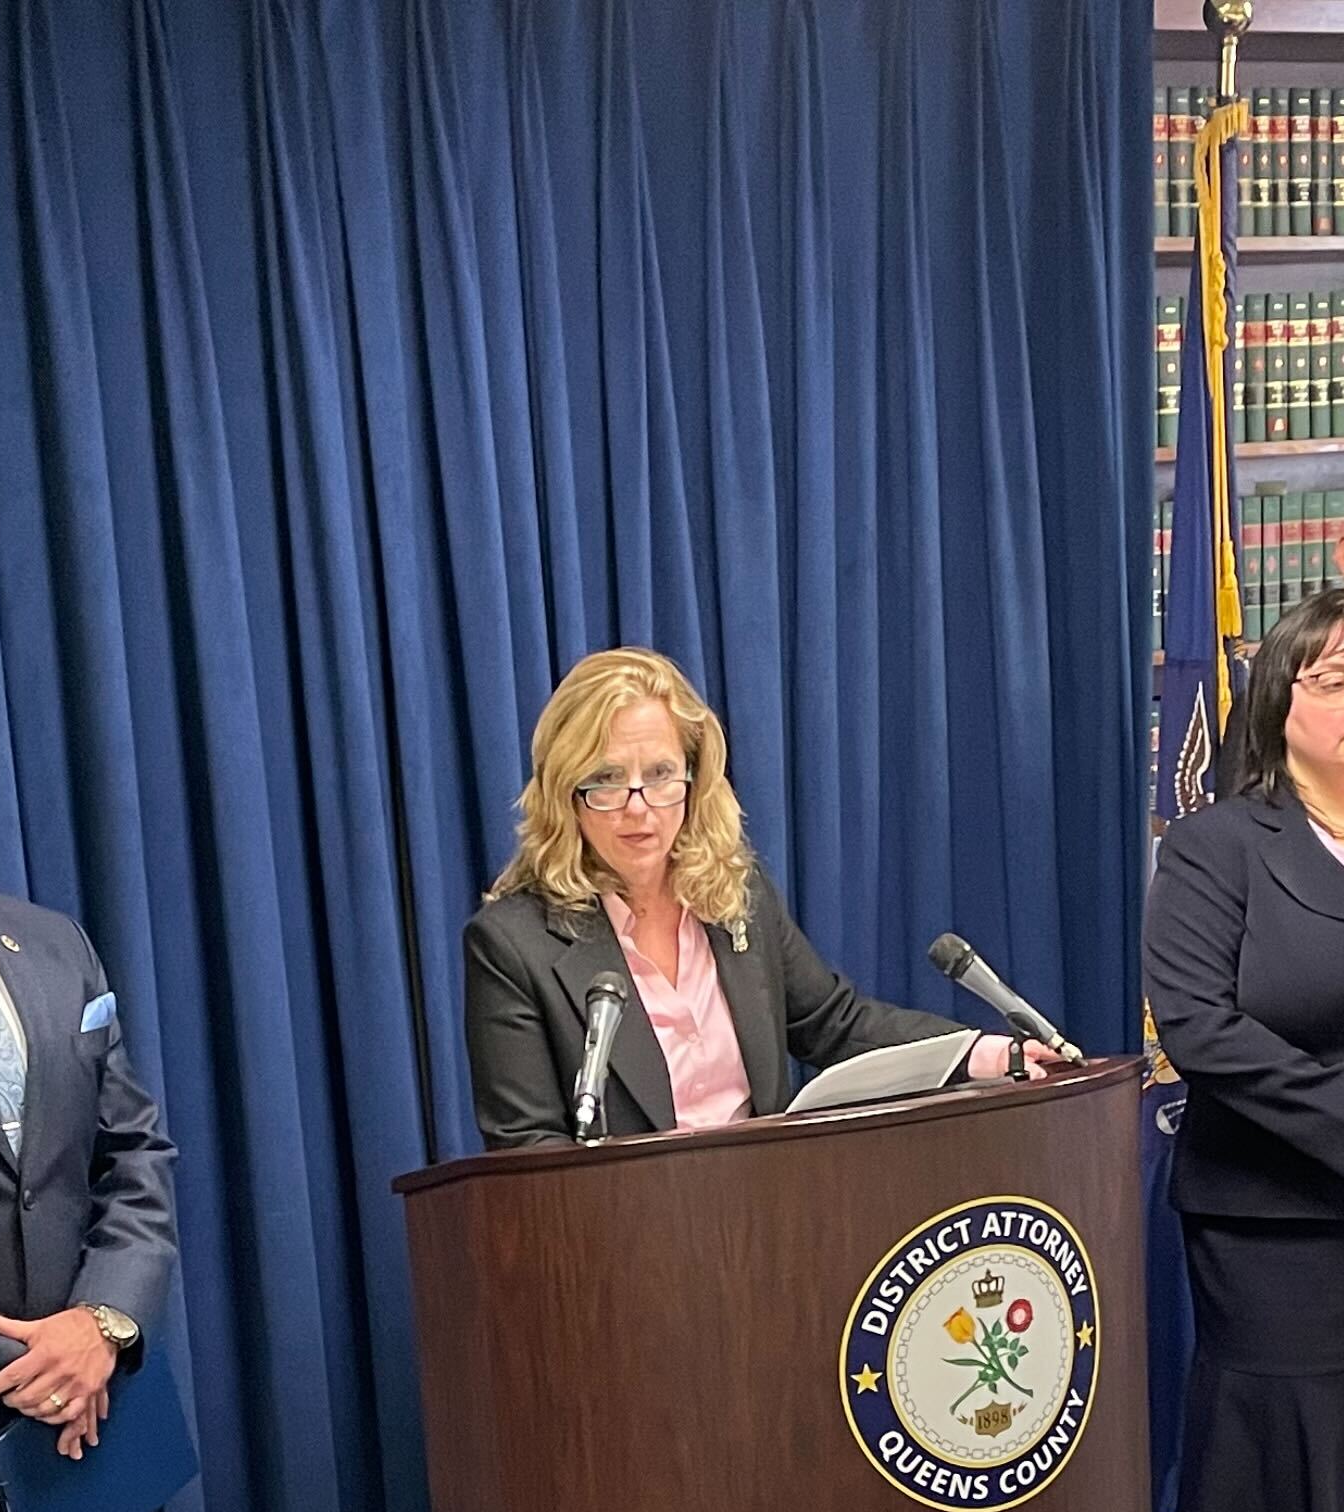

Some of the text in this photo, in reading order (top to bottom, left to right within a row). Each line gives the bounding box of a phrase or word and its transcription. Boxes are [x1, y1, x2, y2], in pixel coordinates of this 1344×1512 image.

[860, 1210, 1089, 1337] DISTRICT ATTORNEY
[877, 1388, 1085, 1500] QUEENS COUNTY
[976, 1409, 1010, 1431] 1898
